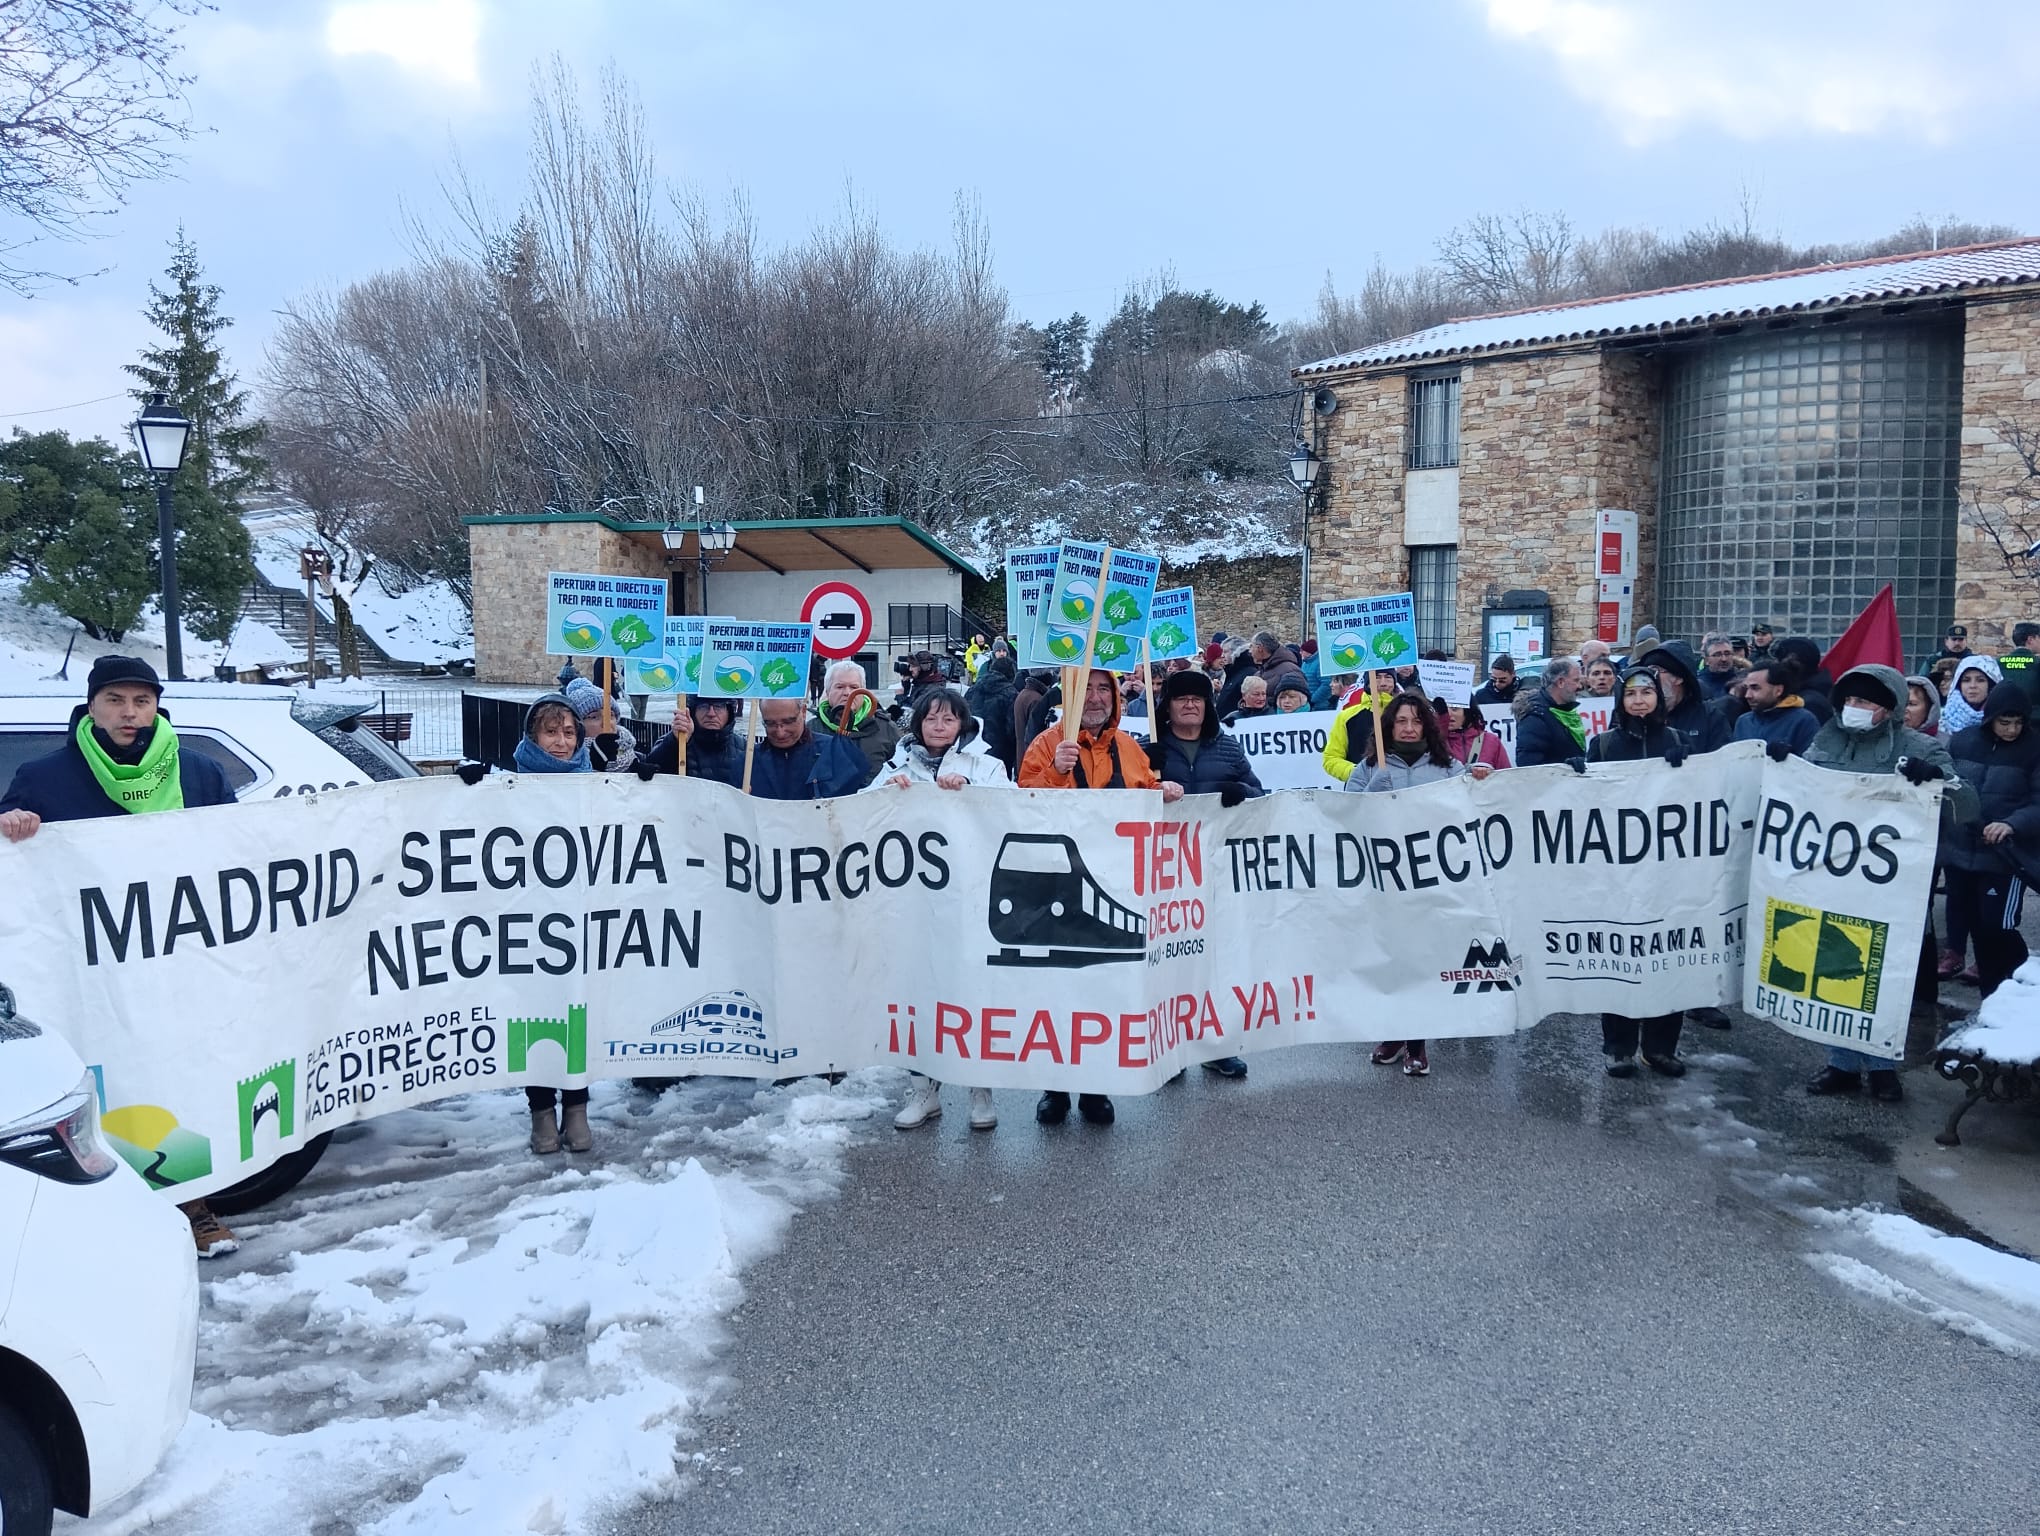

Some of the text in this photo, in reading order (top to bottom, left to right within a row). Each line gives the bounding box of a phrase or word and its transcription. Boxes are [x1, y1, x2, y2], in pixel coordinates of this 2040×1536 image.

[1011, 552, 1059, 567] APERTURA DE
[1063, 544, 1098, 562] APERTURA
[1113, 554, 1144, 571] DIRECTO
[1145, 561, 1156, 574] YA
[1016, 568, 1055, 582] TREN PARA
[1063, 561, 1080, 575] TREN
[1080, 564, 1101, 579] PARA
[1112, 571, 1149, 588] NORDESTE
[553, 578, 663, 596] APERTURA DEL DIRECTO YA
[1180, 591, 1190, 602] YA
[557, 593, 659, 610] TREN PARA EL NORDESTE
[1026, 604, 1038, 617] TR
[1319, 598, 1411, 617] APERTURA DEL DIRECTO YA
[1152, 605, 1188, 618] NORDESTE
[670, 622, 685, 632] DEL
[687, 622, 705, 632] DIRE
[1324, 612, 1409, 631] TREN PARA EL NORDESTE
[677, 636, 687, 647] EL
[689, 636, 704, 647] NOR
[709, 625, 810, 639] APERTURA DEL DIRECTO YA
[712, 640, 805, 653] TREN PARA EL NORDESTE
[1224, 833, 1317, 893] TREN
[1335, 814, 1513, 892] DIRECTO
[1531, 799, 1729, 865] MADRID
[1757, 795, 1902, 885] RGOS
[79, 847, 361, 966] MADRID
[397, 824, 668, 898] SEGOVIA
[724, 831, 950, 904] BURGOS
[1827, 913, 1872, 929] SIERRA
[1546, 917, 1744, 958] SONORAMA RI
[367, 908, 702, 996] NECESITAN
[1166, 938, 1205, 958] BURGOS
[1440, 968, 1495, 982] SIERRA
[1577, 958, 1643, 975] ARANDA
[1652, 958, 1669, 973] DE
[1863, 923, 1886, 1013] NORTE DE MADRID
[1756, 985, 1873, 1042] GALSINMA
[935, 990, 1225, 1069] REAPERTURA
[1231, 980, 1281, 1032] YA
[307, 1006, 496, 1069] PLATAFORMA POR EL
[340, 1025, 496, 1083] DIRECTO
[603, 1039, 798, 1065] Translozoya
[305, 1083, 376, 1124] MADRID
[402, 1057, 497, 1093] BURGOS
